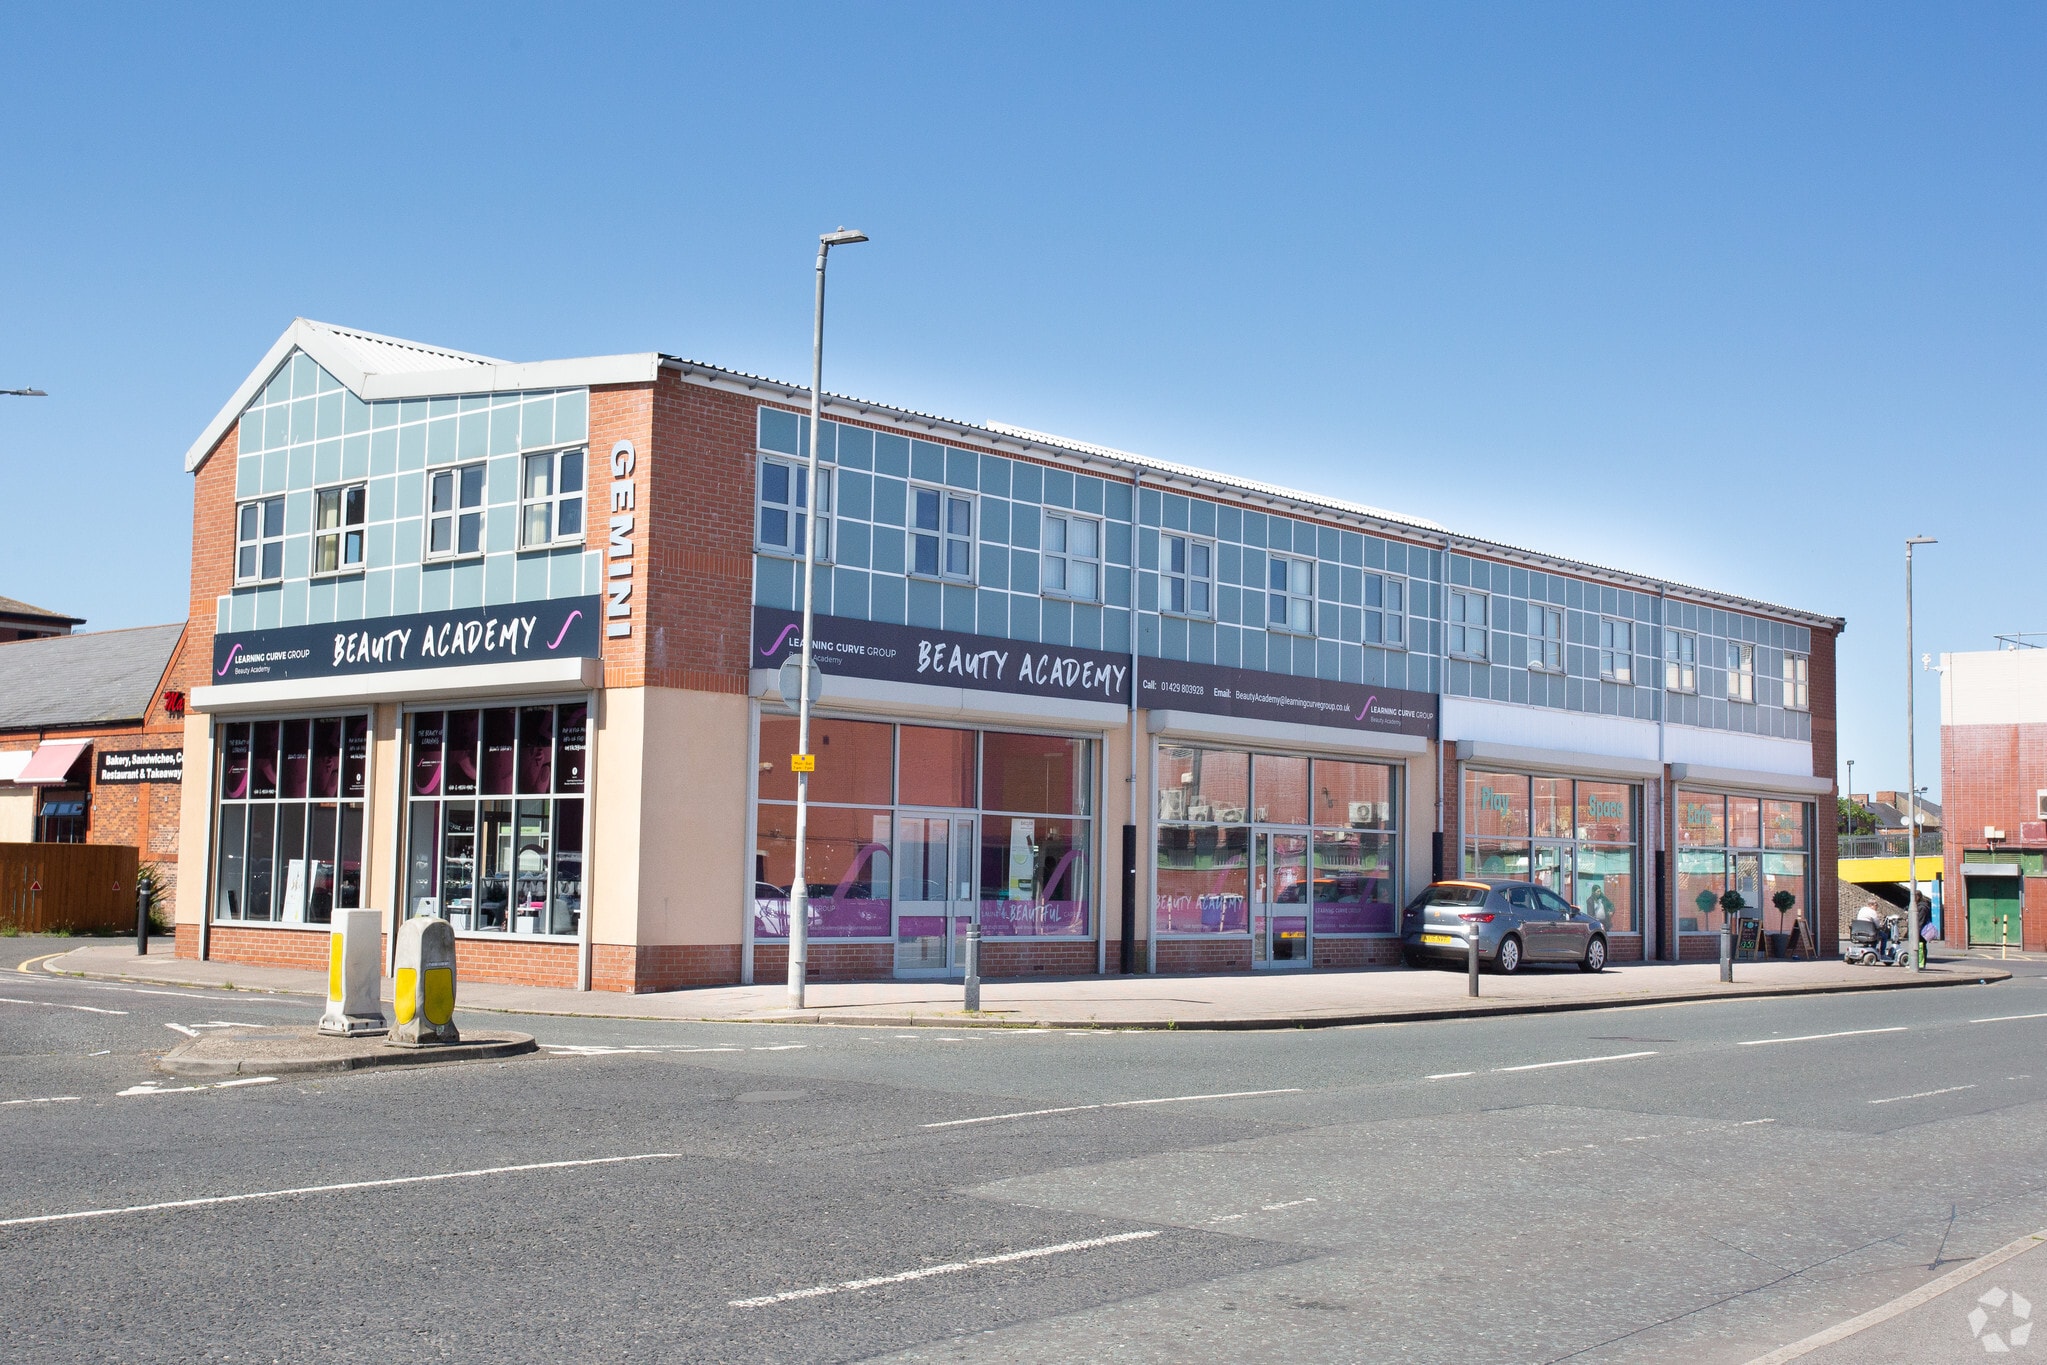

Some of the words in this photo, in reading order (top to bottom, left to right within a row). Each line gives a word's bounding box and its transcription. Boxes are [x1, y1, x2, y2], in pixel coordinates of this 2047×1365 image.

[607, 439, 635, 637] GEMINI
[332, 627, 412, 667] BEAUTY
[421, 615, 537, 656] ACADEMY
[234, 651, 265, 664] LEARNING
[266, 650, 287, 661] CURVE
[287, 649, 310, 660] GROUP
[836, 643, 865, 655] CURVE
[867, 646, 897, 658] GROUP
[813, 655, 843, 666] Academy
[917, 639, 1009, 680] BEAUTY
[1019, 652, 1127, 697] ACADEMY
[234, 667, 250, 675] Beauty
[250, 665, 270, 674] Academy
[1142, 679, 1157, 690] Call:
[1161, 681, 1181, 694] 01429
[1181, 683, 1204, 696] 803928
[1213, 687, 1232, 699] Email:
[1235, 690, 1351, 713] BeautyAcademy@learningcurvegroup.co.uk
[1370, 705, 1397, 716] LEARNING
[1397, 709, 1415, 718] CURVE
[1415, 711, 1434, 720] GROUP
[105, 754, 131, 767] Bakery,
[131, 751, 176, 765] Sandwiches,
[101, 768, 139, 780] Restaurant
[139, 768, 146, 779] &
[146, 767, 183, 780] Takeaway
[1481, 786, 1509, 817] Play
[1588, 793, 1624, 822] Space
